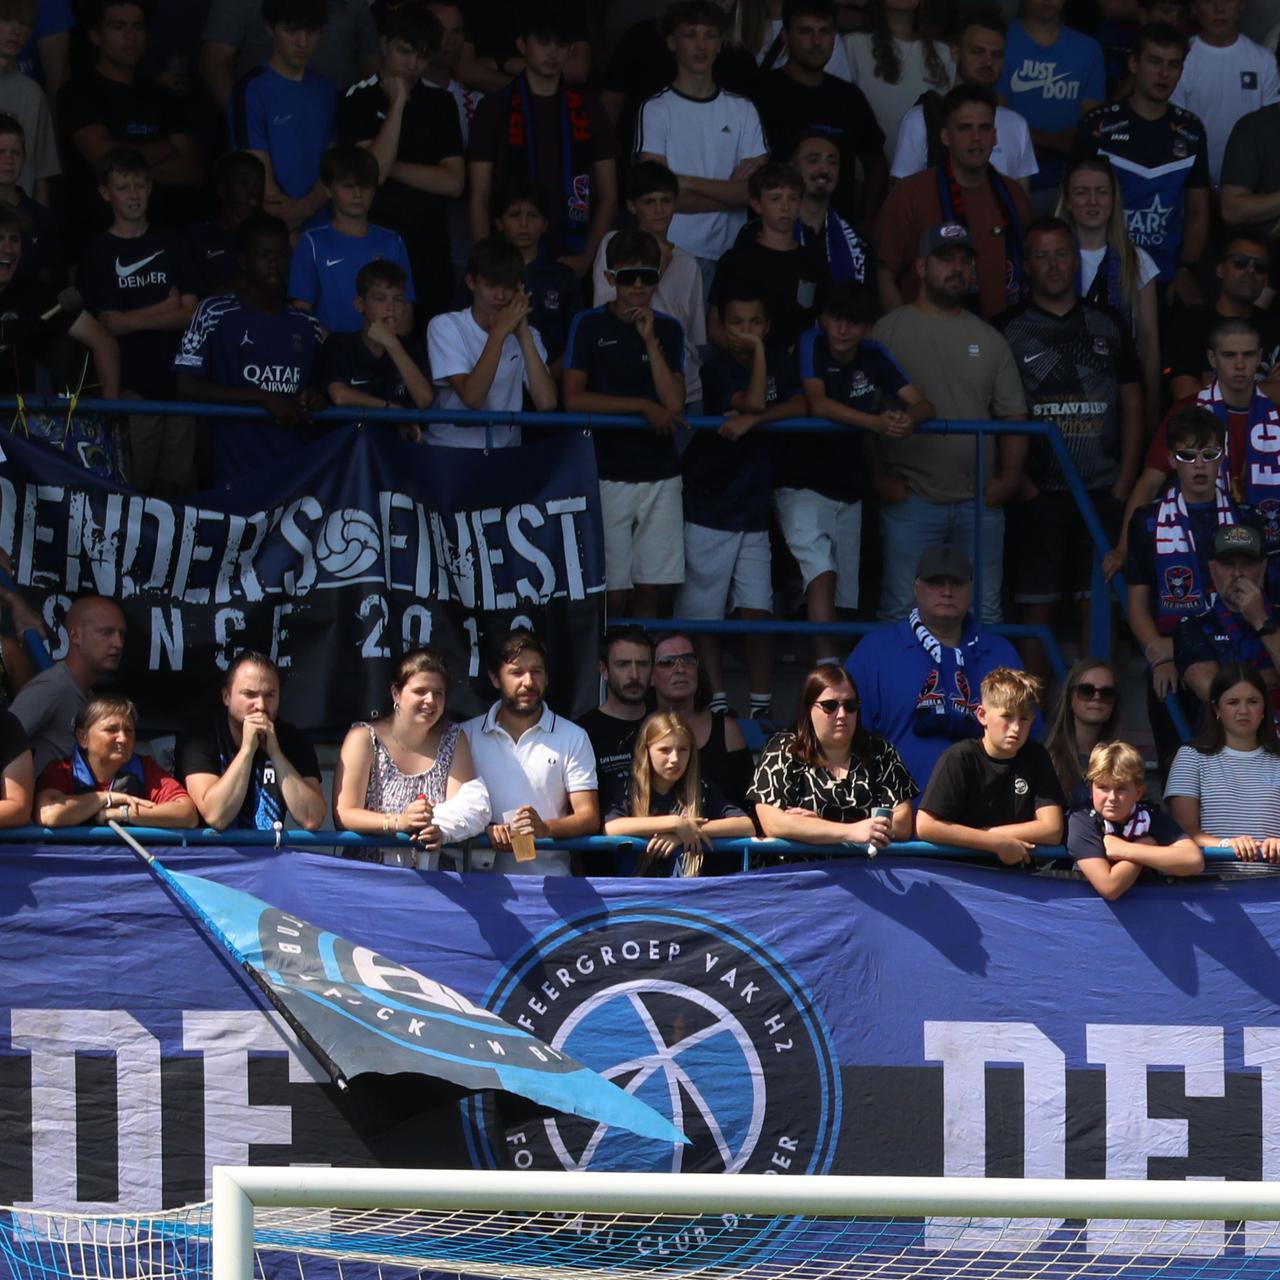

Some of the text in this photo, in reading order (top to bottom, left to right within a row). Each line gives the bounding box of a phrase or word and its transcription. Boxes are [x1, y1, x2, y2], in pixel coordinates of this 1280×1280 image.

[1019, 59, 1056, 79] JUST
[1124, 210, 1164, 234] TAR
[1128, 232, 1164, 246] SINO
[379, 490, 587, 611] FINEST
[42, 594, 303, 672] SNCE
[518, 940, 795, 1054] FEERGROEP VAK H2
